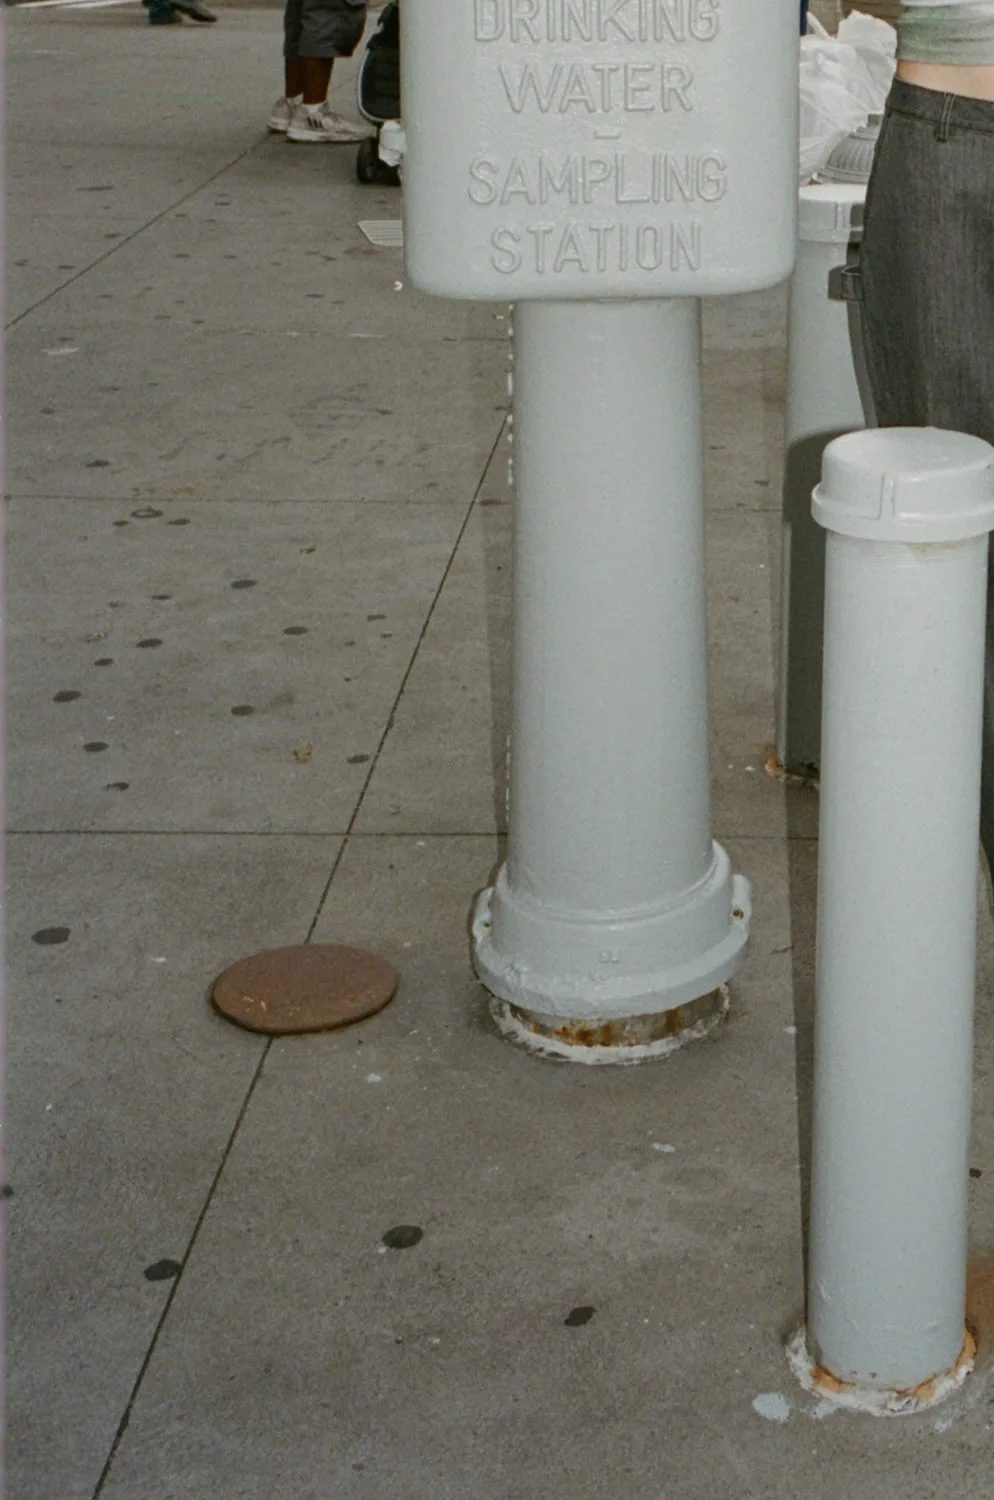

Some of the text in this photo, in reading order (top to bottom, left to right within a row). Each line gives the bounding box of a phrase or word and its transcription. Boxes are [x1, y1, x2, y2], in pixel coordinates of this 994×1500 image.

[498, 62, 695, 112] WATER
[466, 153, 728, 205] SAMPLING
[490, 223, 700, 275] STATION
